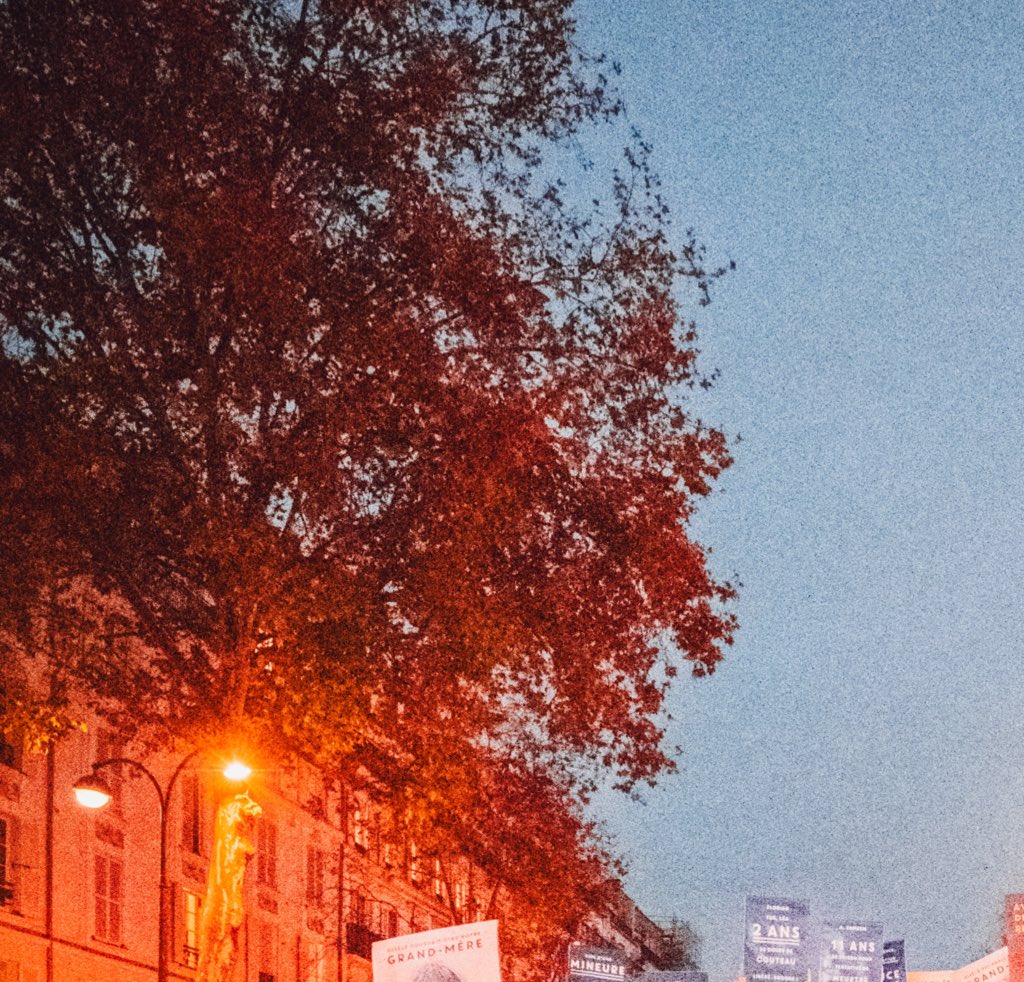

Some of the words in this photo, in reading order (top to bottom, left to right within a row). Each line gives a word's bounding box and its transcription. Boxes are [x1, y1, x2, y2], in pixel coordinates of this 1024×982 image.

[752, 923, 761, 936] 2
[768, 925, 800, 939] ANS
[387, 939, 483, 965] GRAND-MÈRE
[849, 941, 875, 952] ANS
[570, 959, 625, 976] MINEURE
[756, 955, 796, 965] COUTEAU
